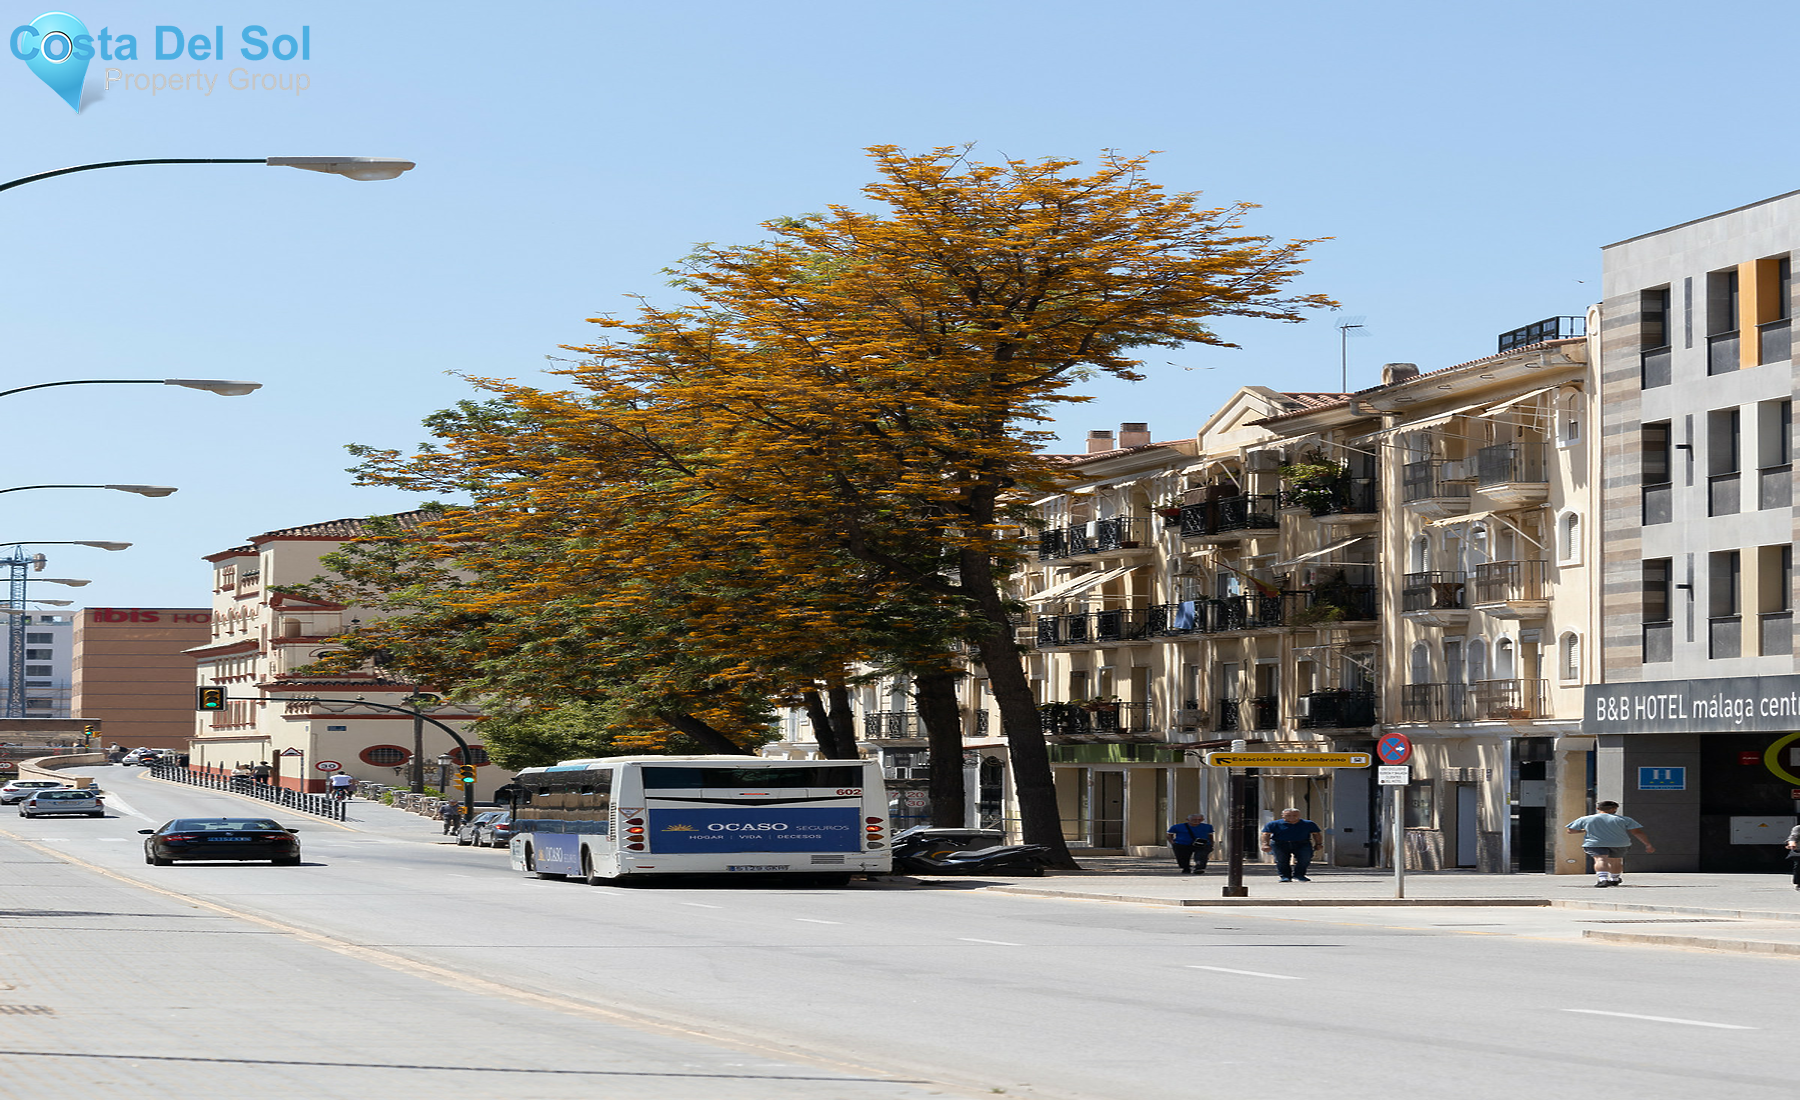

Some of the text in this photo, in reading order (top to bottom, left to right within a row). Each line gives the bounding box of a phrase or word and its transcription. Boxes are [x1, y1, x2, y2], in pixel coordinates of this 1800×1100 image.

[94, 608, 160, 623] ibis
[1596, 697, 1630, 721] B&B
[1635, 695, 1688, 720] HOTEL
[1693, 693, 1753, 724] málaga
[1653, 769, 1671, 780] H
[836, 788, 862, 796] 602
[707, 823, 789, 832] OCASO
